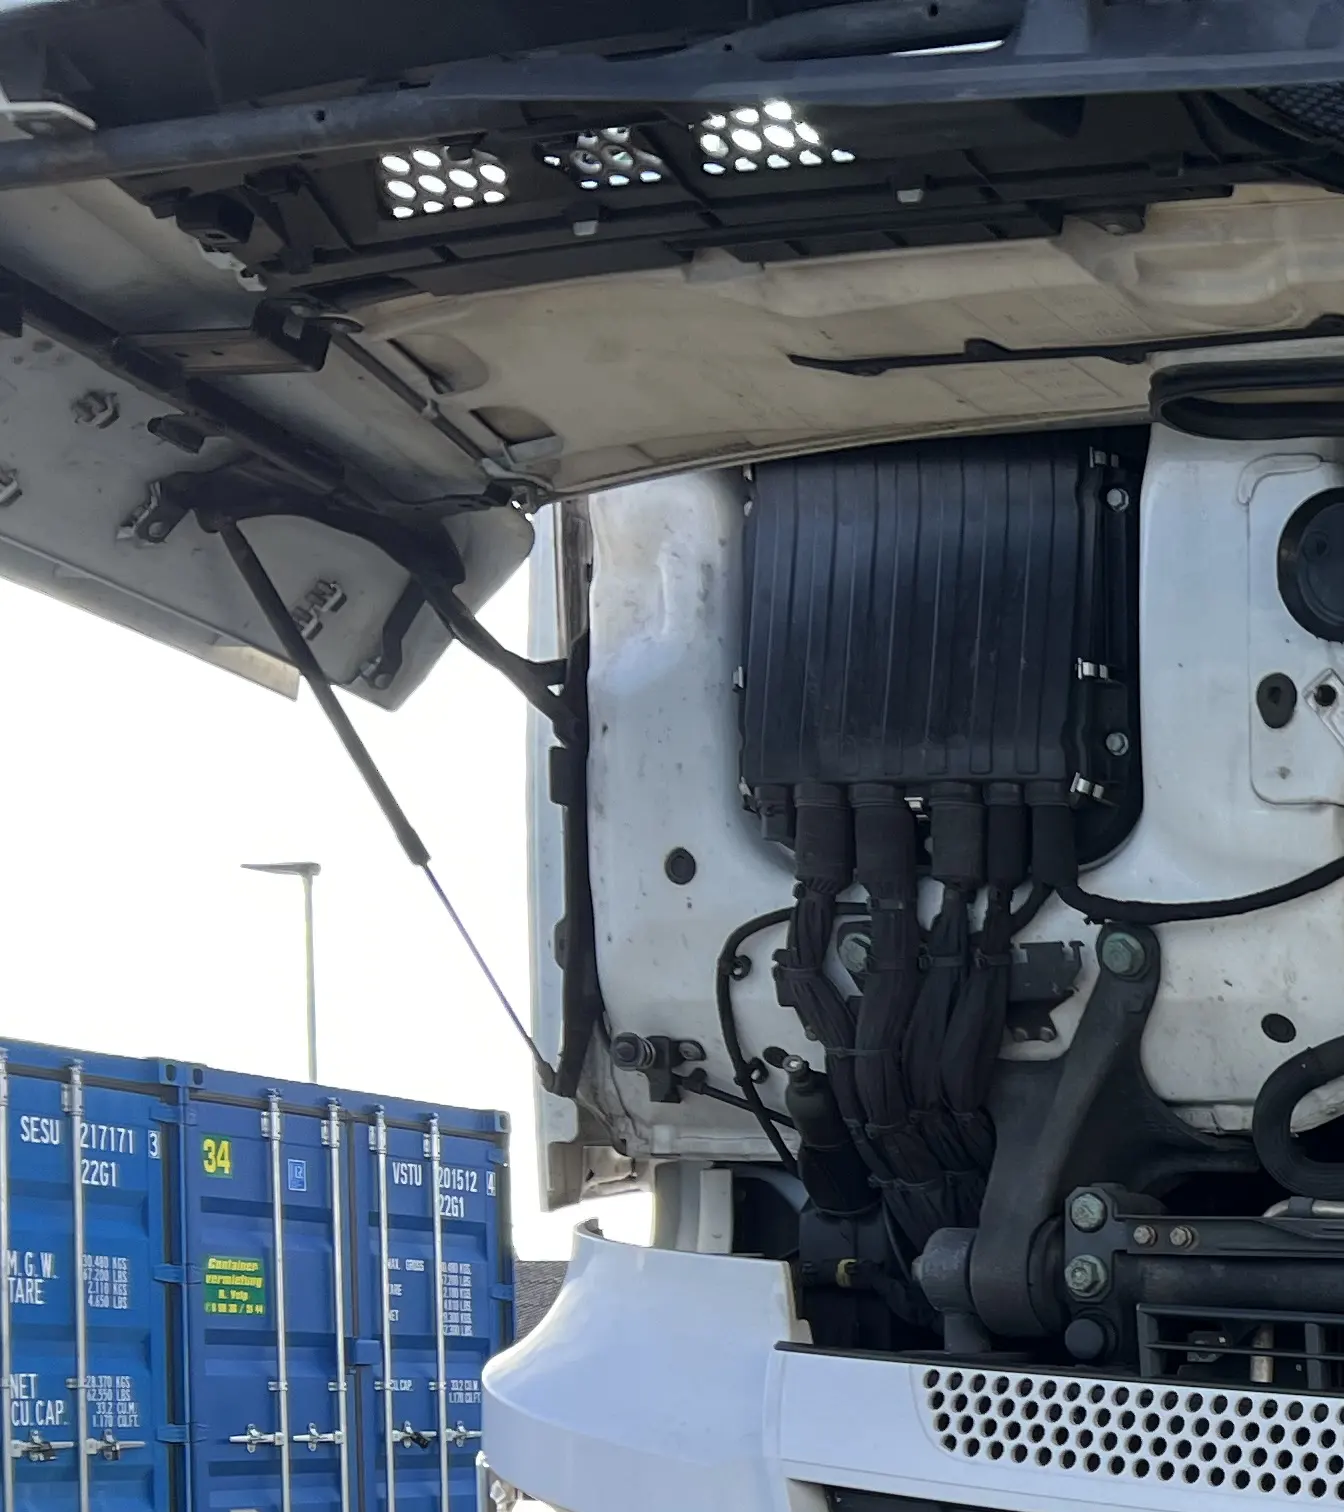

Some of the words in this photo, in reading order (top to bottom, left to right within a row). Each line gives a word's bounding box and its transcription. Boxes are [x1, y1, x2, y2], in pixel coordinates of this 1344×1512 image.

[20, 1115, 60, 1145] SESU
[80, 1122, 134, 1154] 217171
[149, 1131, 159, 1157] 3
[203, 1138, 231, 1174] 34
[81, 1158, 117, 1187] 22G1
[392, 1162, 422, 1186] VSTU
[439, 1166, 478, 1193] 201512
[8, 1277, 46, 1305] TARE
[10, 1373, 38, 1399] NET
